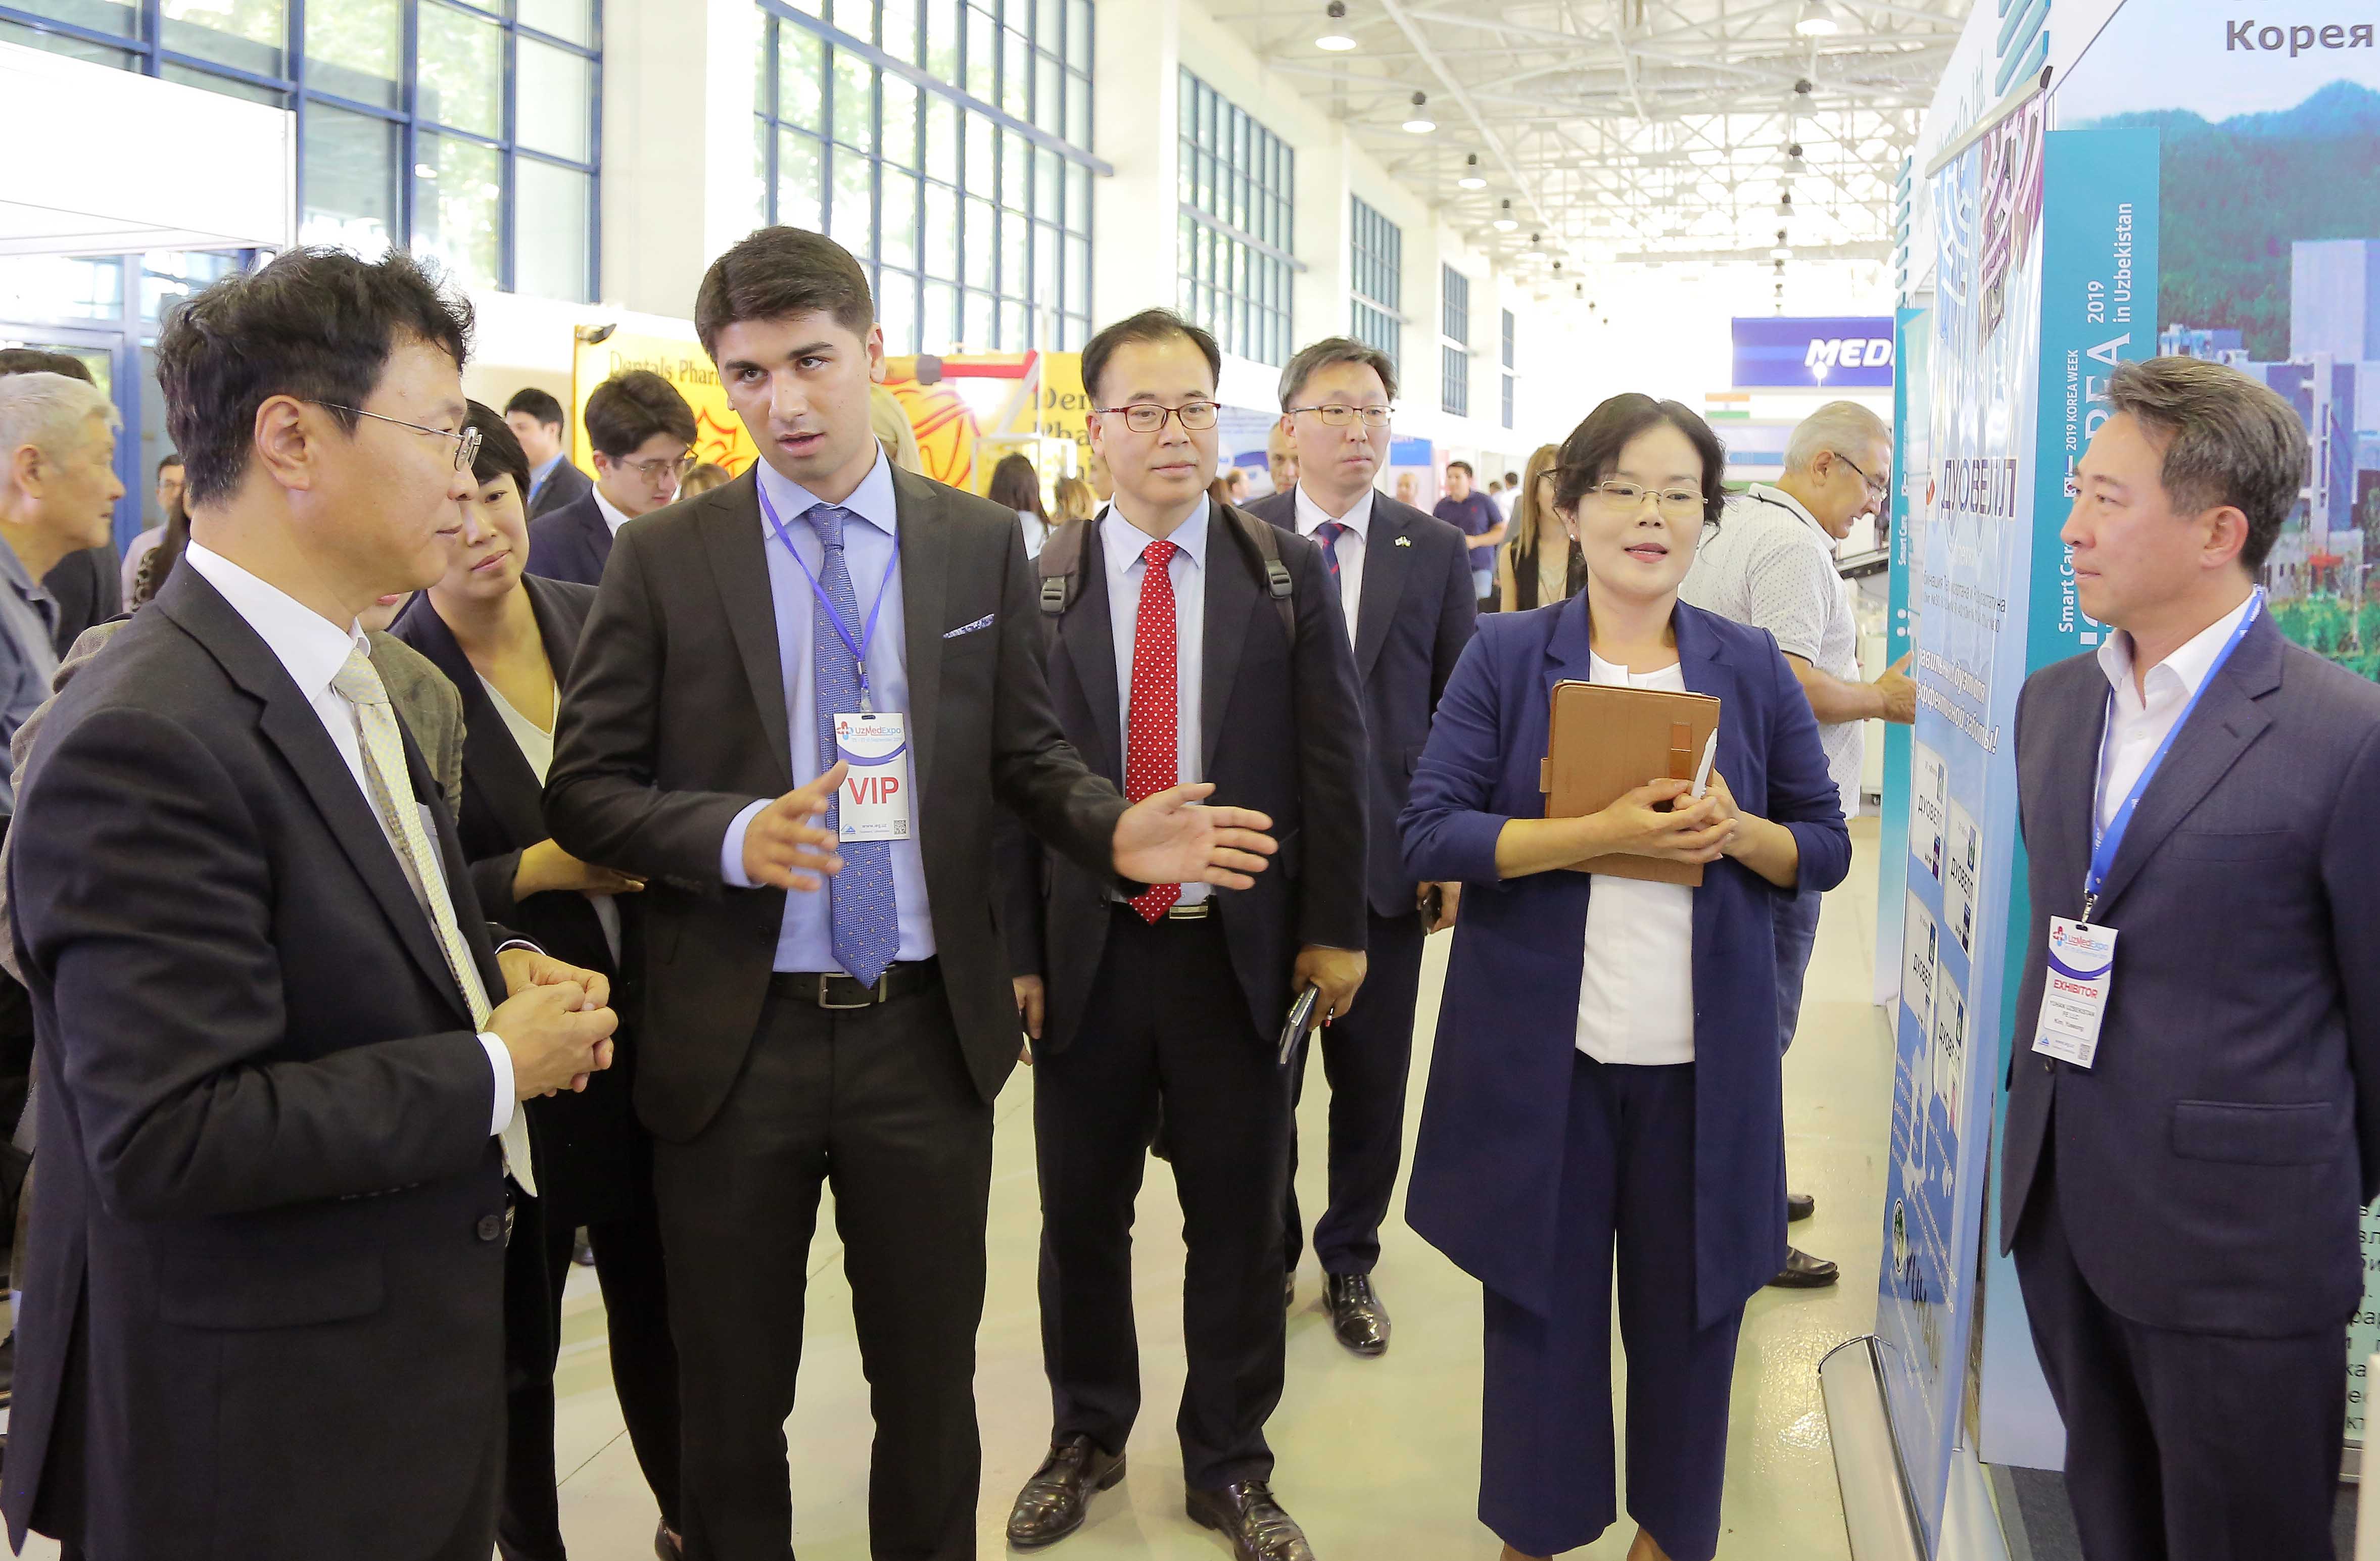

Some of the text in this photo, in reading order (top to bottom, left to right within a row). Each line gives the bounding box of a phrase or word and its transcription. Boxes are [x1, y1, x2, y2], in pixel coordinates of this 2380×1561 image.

[2226, 20, 2373, 57] Корея
[2113, 202, 2132, 323] in Uzbekistan
[2087, 280, 2105, 323] 2019
[1804, 338, 1894, 368] MED
[2066, 350, 2078, 450] 2019 KOREA WEEK
[1941, 459, 2017, 520] ДУОВЕЛЛ
[2059, 544, 2075, 633] Smart Car
[848, 777, 899, 804] VIP
[2054, 979, 2098, 998] EXHIBITOR
